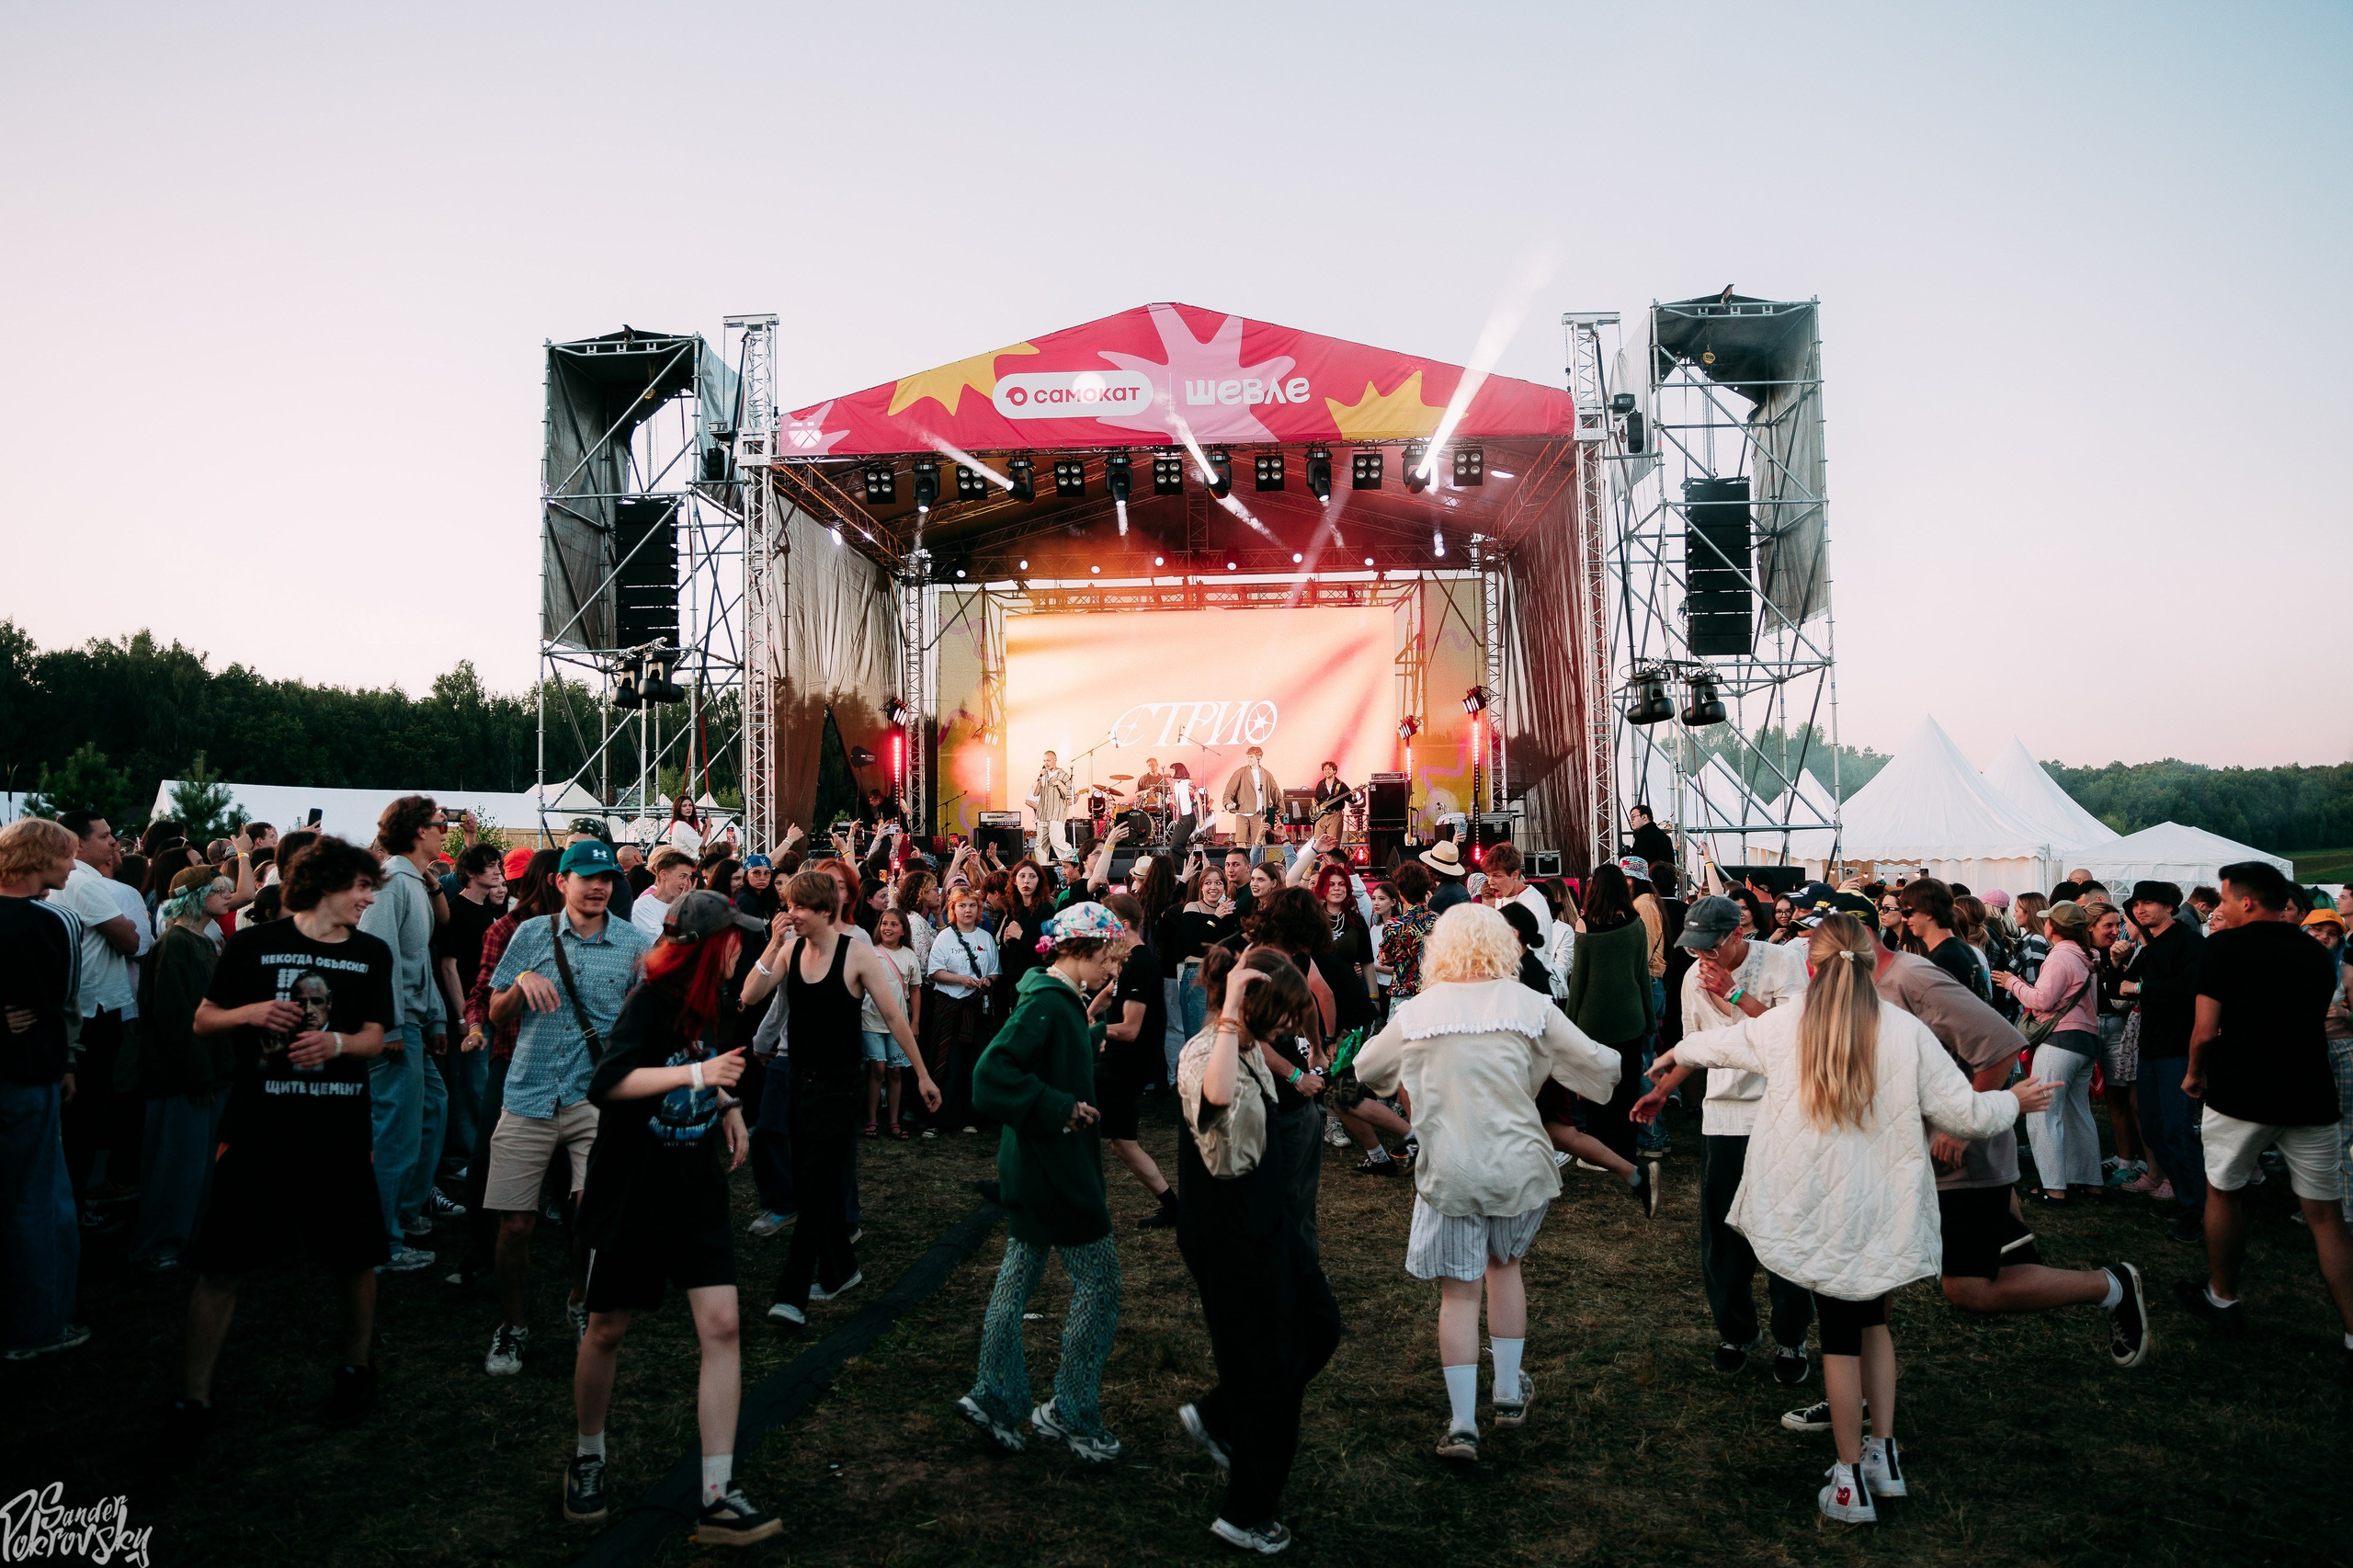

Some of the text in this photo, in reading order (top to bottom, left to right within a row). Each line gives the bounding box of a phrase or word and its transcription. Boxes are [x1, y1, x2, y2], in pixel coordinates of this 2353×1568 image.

[261, 953, 369, 974] НЕКОГДА ОБЪЯСНЯ
[309, 1081, 364, 1096] ЦЕМЕНТ
